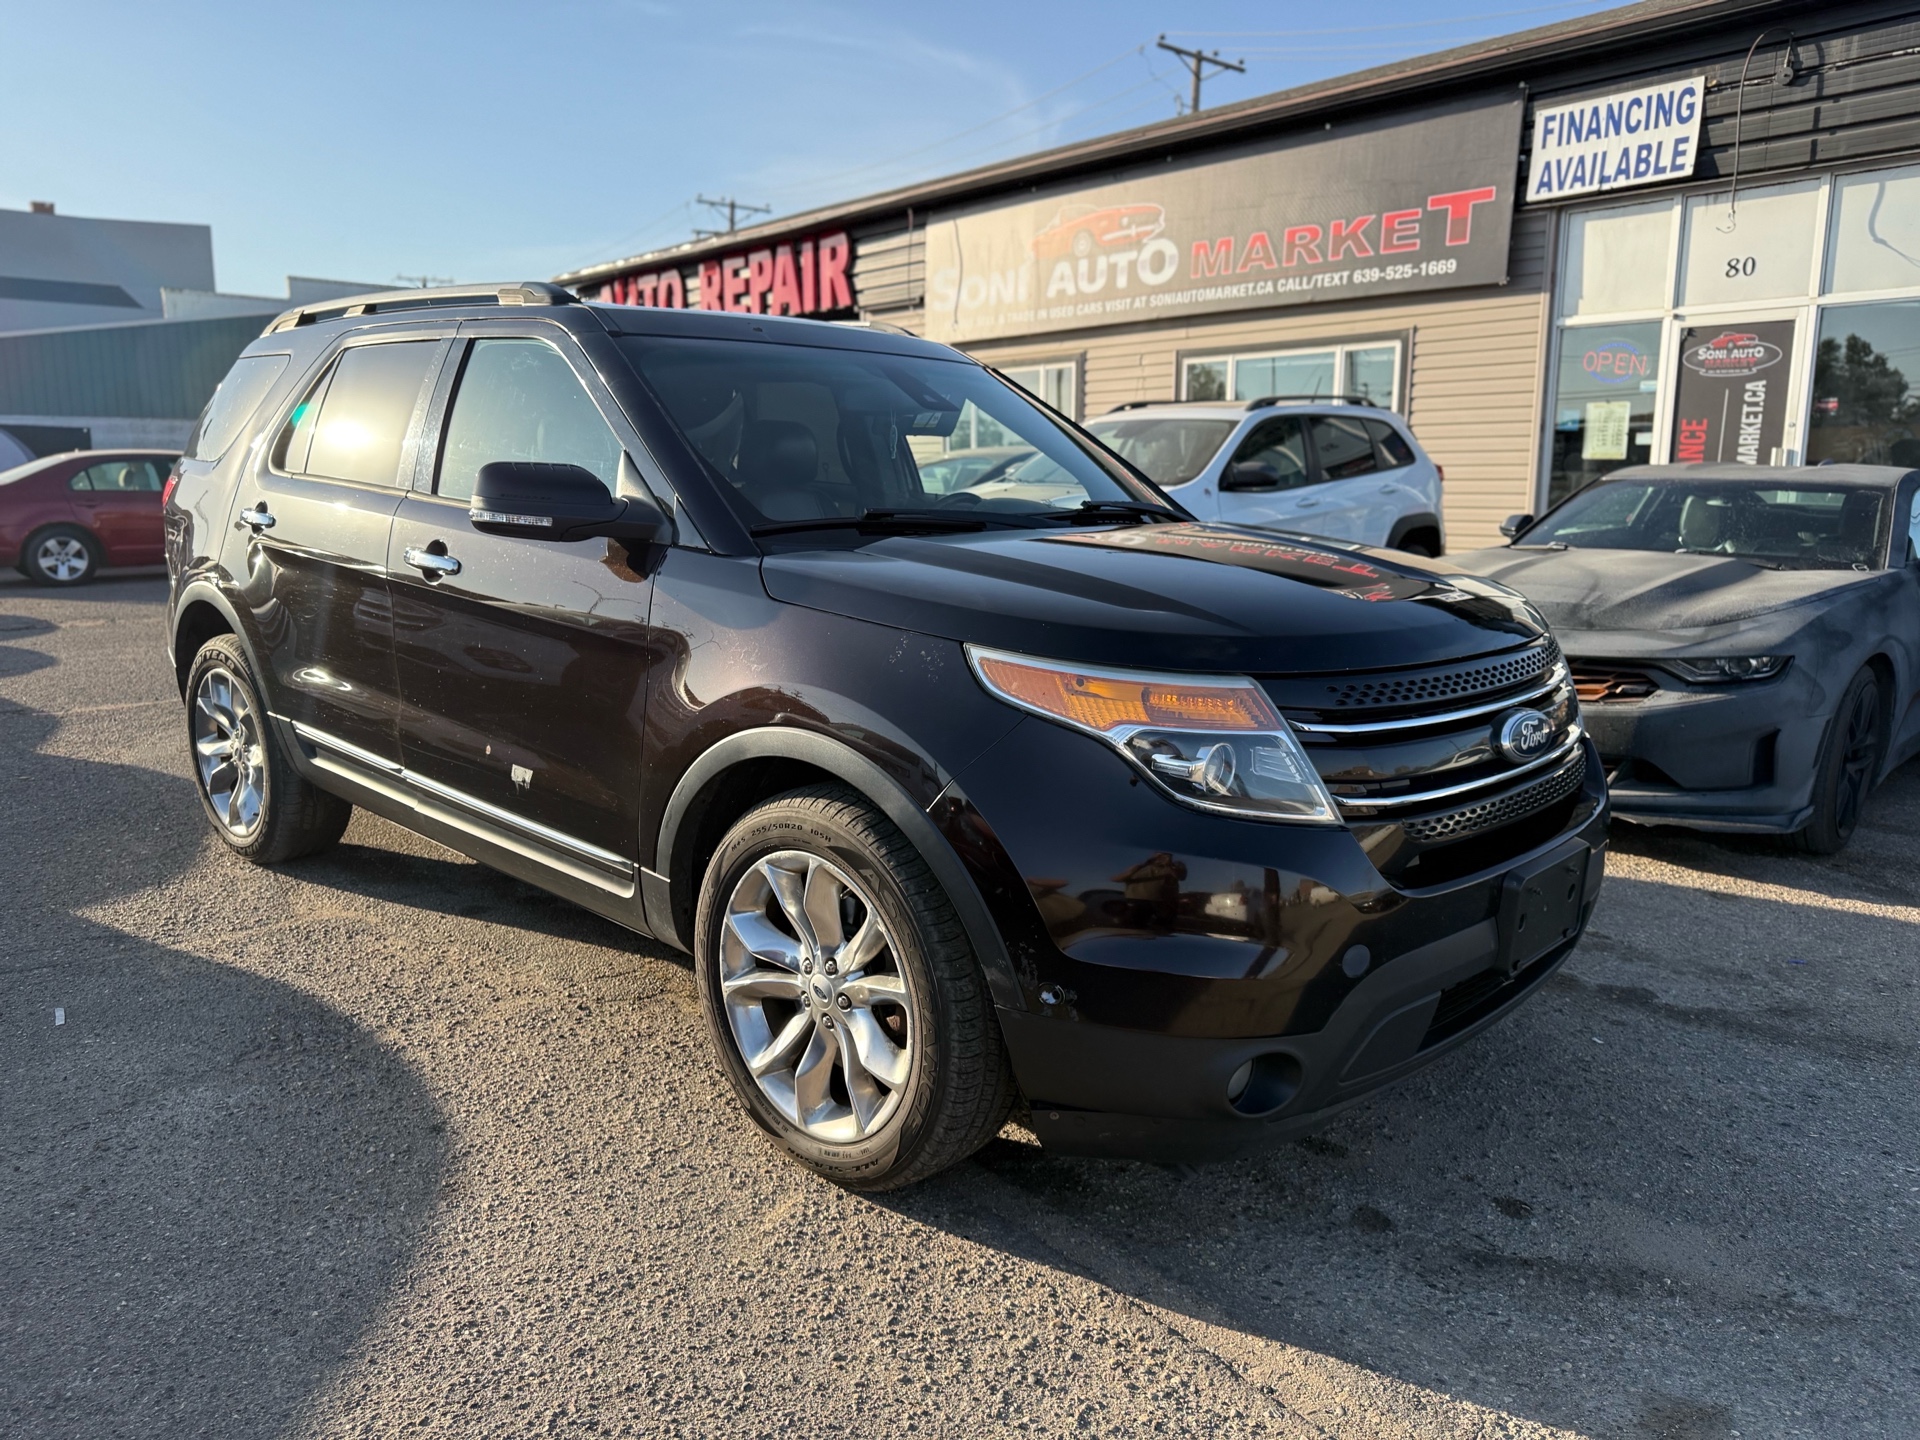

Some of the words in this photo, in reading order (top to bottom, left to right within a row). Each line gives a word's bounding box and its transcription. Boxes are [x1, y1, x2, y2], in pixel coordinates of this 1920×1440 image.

[1541, 86, 1697, 150] FINANCING
[1534, 136, 1691, 195] AVAILABLE
[931, 262, 1027, 313] SONI
[1046, 237, 1179, 298] AUTO
[1190, 186, 1496, 279] MARKET
[1725, 257, 1756, 278] 80
[698, 230, 853, 316] REPAIR
[1049, 305, 1075, 319] USED
[1076, 302, 1103, 315] CARS
[1105, 298, 1131, 313] VISIT
[1133, 296, 1147, 309] AT
[1149, 280, 1274, 307] SONIAUTOMARKET.CA
[1277, 270, 1350, 292] CALL/TEXT
[1352, 258, 1457, 284] 639-525-1669
[1583, 351, 1647, 376] OPEN
[1697, 347, 1728, 360] SONI
[1731, 346, 1765, 359] AUTO
[1520, 719, 1550, 750] Ford
[751, 822, 803, 837] 255/50R20
[810, 828, 832, 843] 105H
